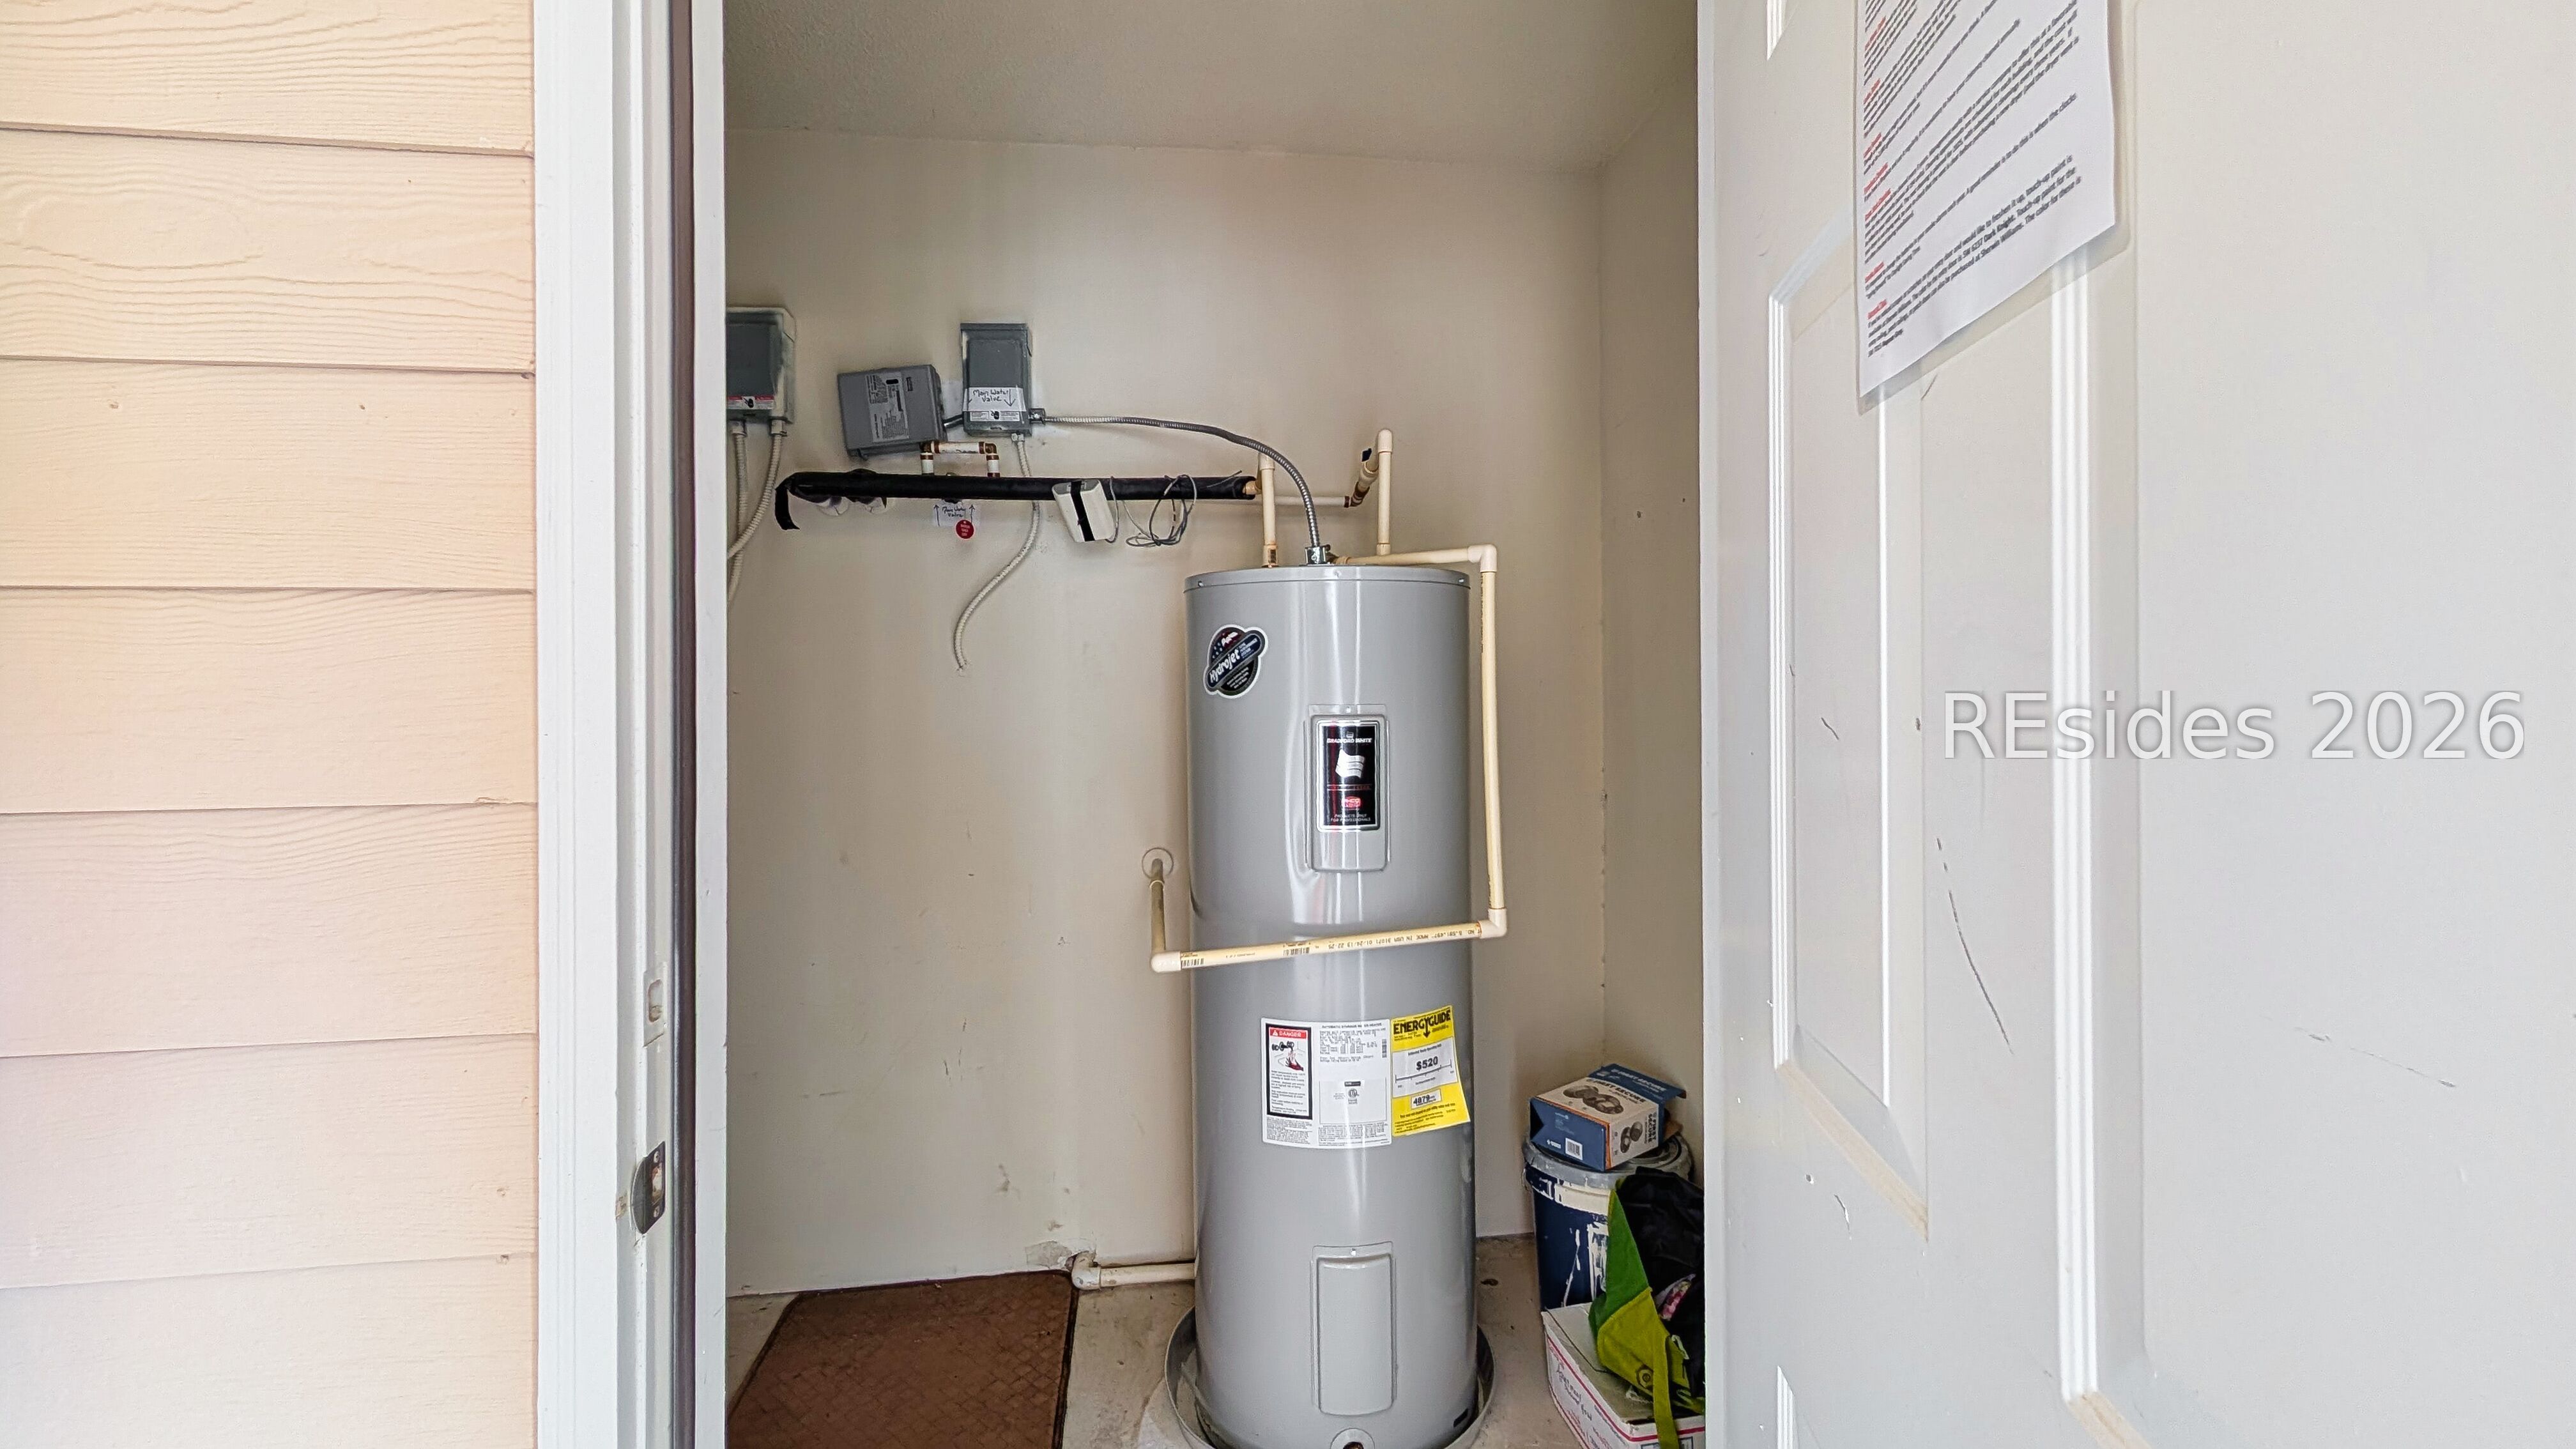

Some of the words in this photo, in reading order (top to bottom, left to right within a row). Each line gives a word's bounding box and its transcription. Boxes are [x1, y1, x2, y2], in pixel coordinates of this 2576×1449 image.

[1209, 649, 1240, 683] Hydrojet
[1393, 1009, 1451, 1035] ENERGYGUIDE
[1416, 1056, 1438, 1071] $520
